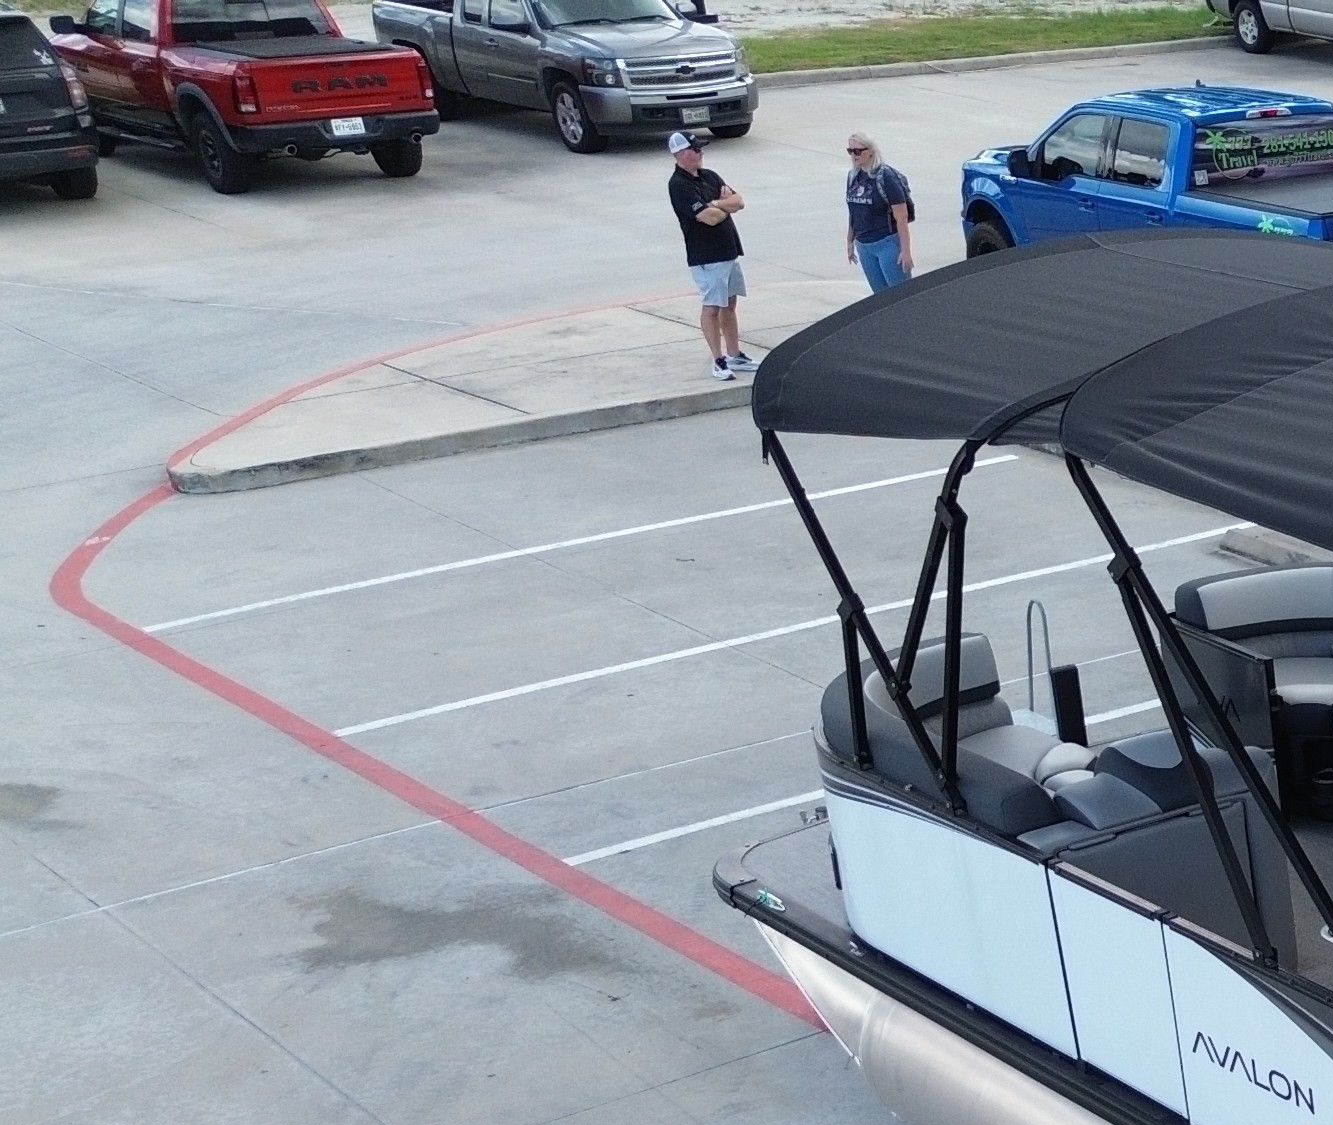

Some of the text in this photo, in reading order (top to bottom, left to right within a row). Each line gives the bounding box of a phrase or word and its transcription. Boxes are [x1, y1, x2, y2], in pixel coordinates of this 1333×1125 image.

[292, 74, 388, 93] RAM
[1218, 149, 1259, 169] Travel
[1192, 1031, 1315, 1115] AVALON
